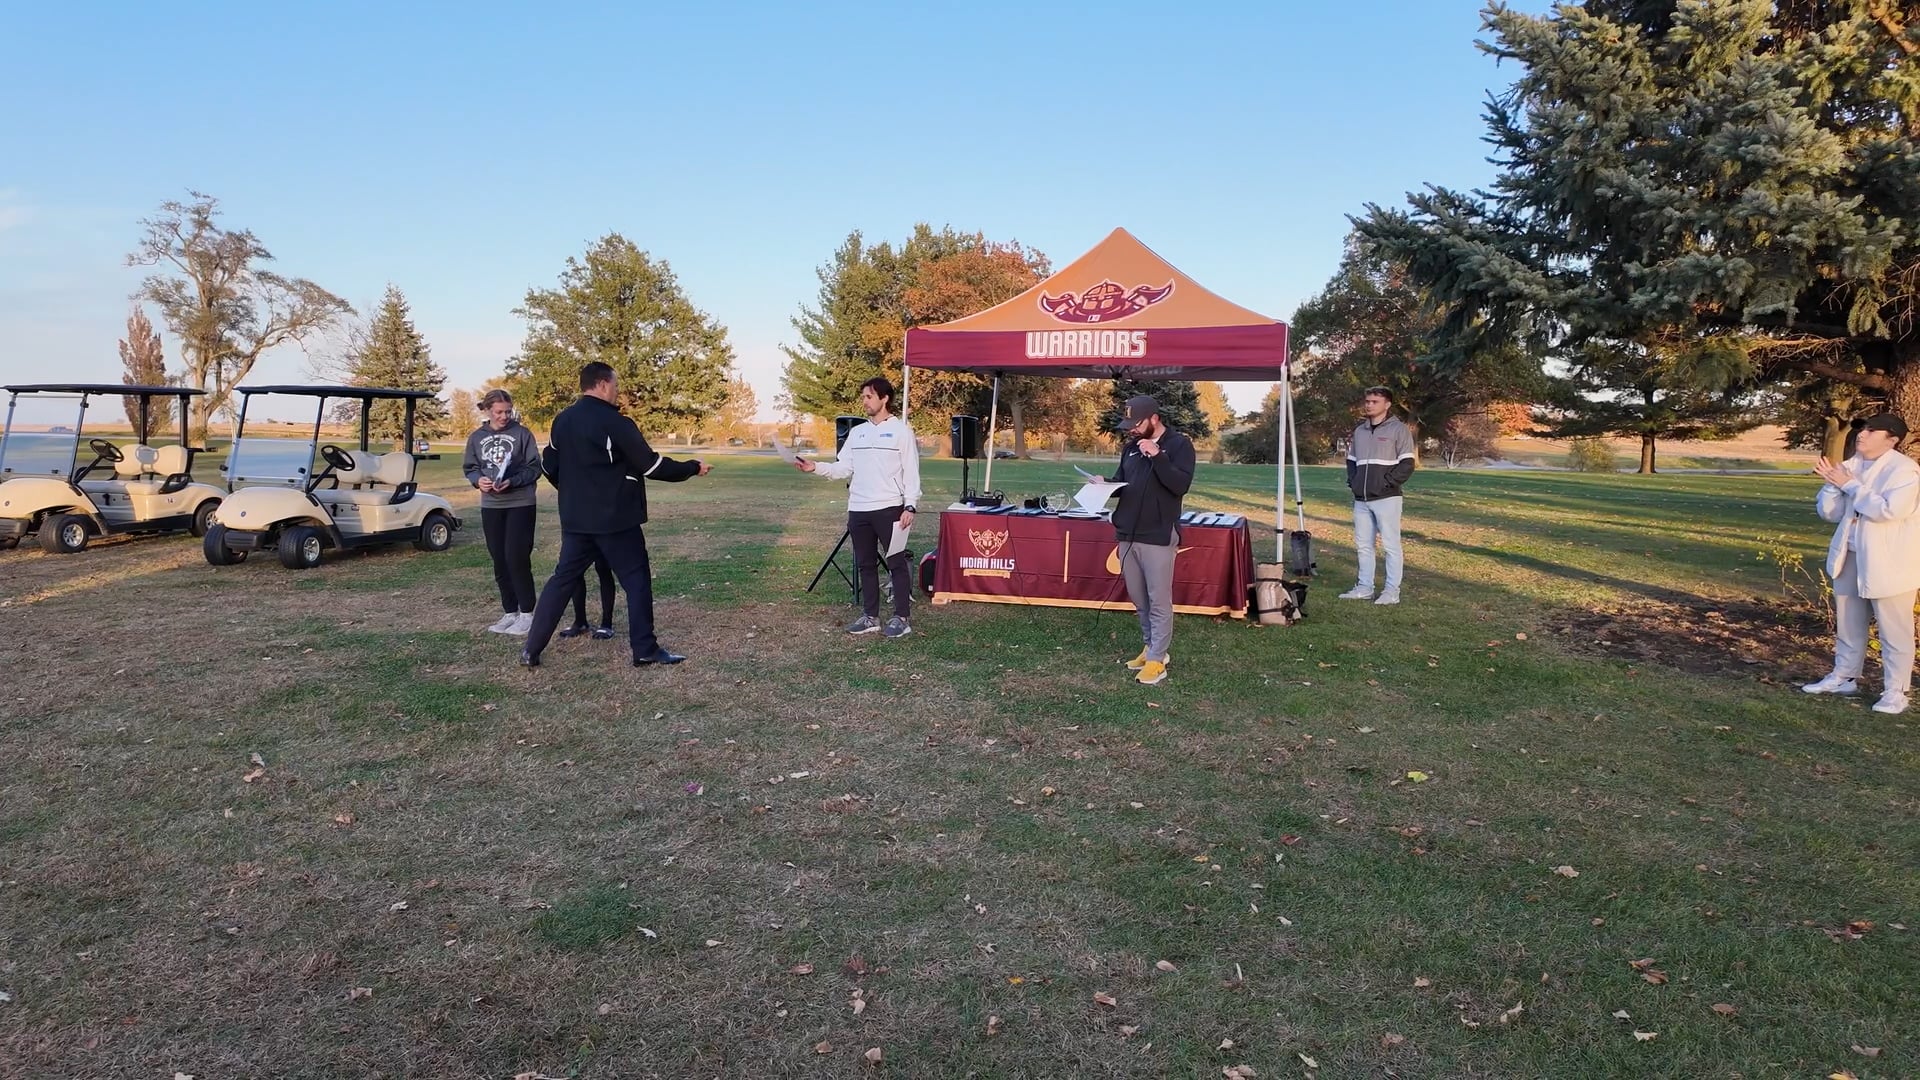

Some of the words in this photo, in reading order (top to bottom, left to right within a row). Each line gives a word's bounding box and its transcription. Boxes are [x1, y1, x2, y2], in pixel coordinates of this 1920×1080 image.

[1025, 330, 1147, 358] WARRIORS
[960, 556, 989, 569] INDIAN
[990, 558, 1015, 570] HILLS
